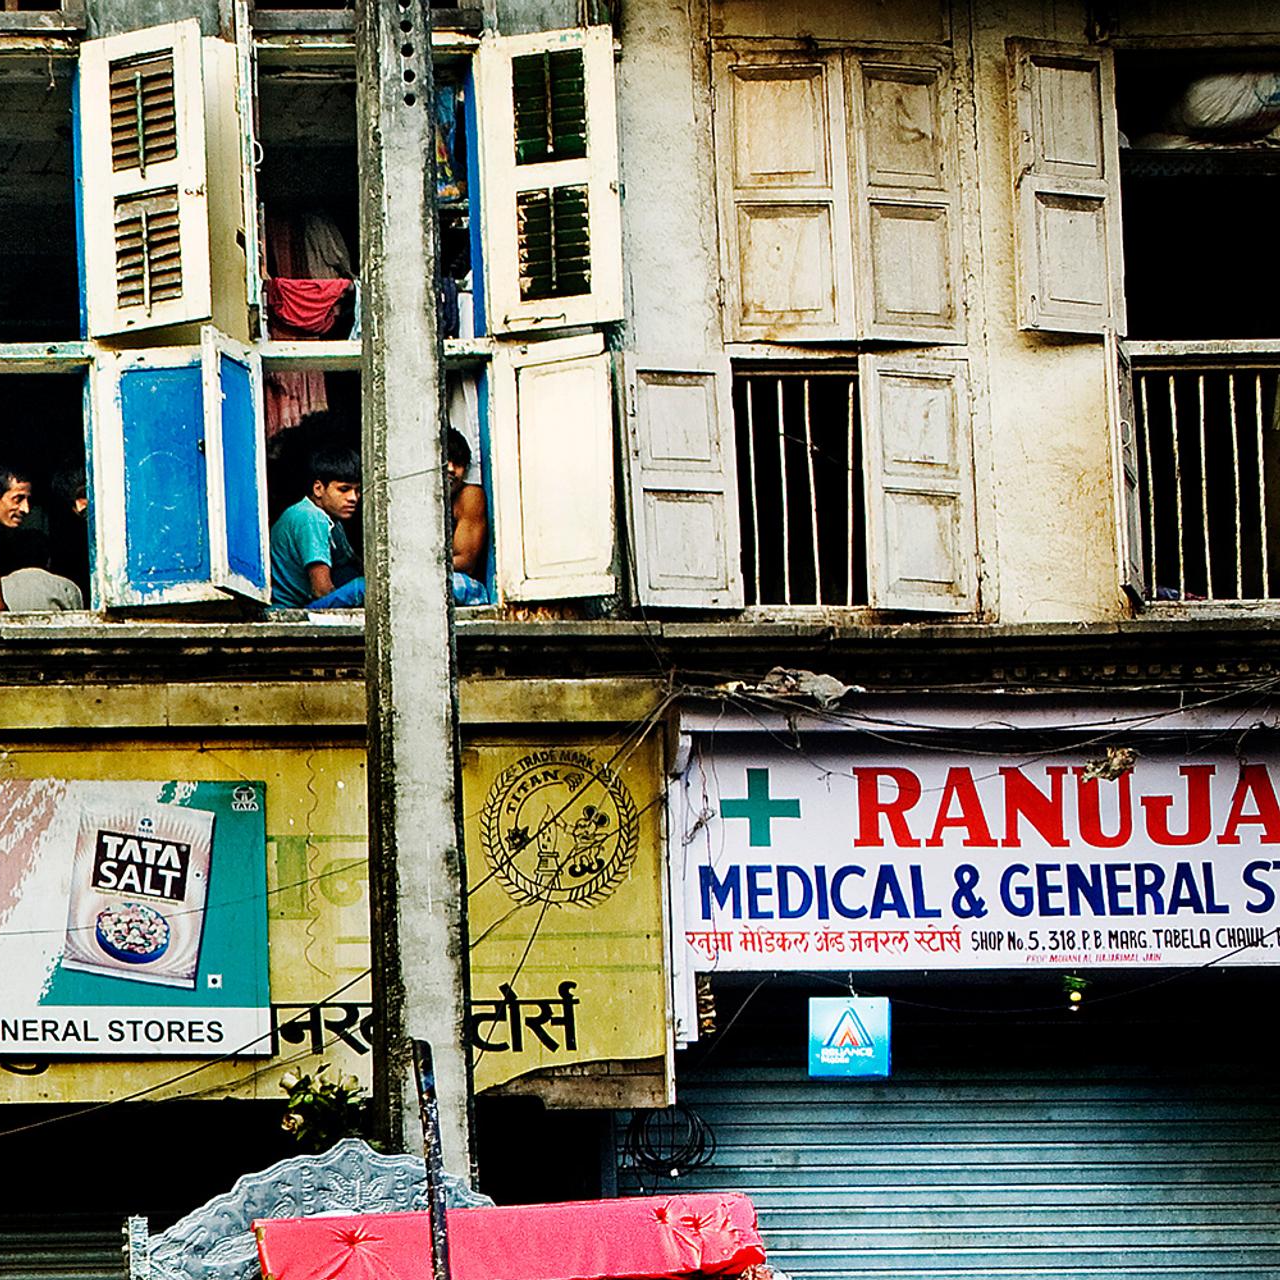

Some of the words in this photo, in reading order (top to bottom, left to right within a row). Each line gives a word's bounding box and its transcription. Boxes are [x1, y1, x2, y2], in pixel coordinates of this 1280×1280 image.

[516, 751, 557, 770] TRADE
[559, 751, 595, 769] MARK
[506, 769, 560, 815] TITAN
[853, 765, 1280, 849] RANUJA
[102, 834, 182, 870] TATA
[98, 861, 181, 898] SALT
[698, 863, 942, 920] MEDICAL
[951, 863, 988, 919] &
[999, 861, 1230, 918] GENERAL
[739, 925, 810, 953] मेडिकल
[848, 930, 910, 953] जनरल
[914, 925, 962, 953] स्टोर्स
[971, 930, 1004, 951] SHOP
[1152, 929, 1211, 949] TABELA
[108, 1019, 224, 1044] STORES
